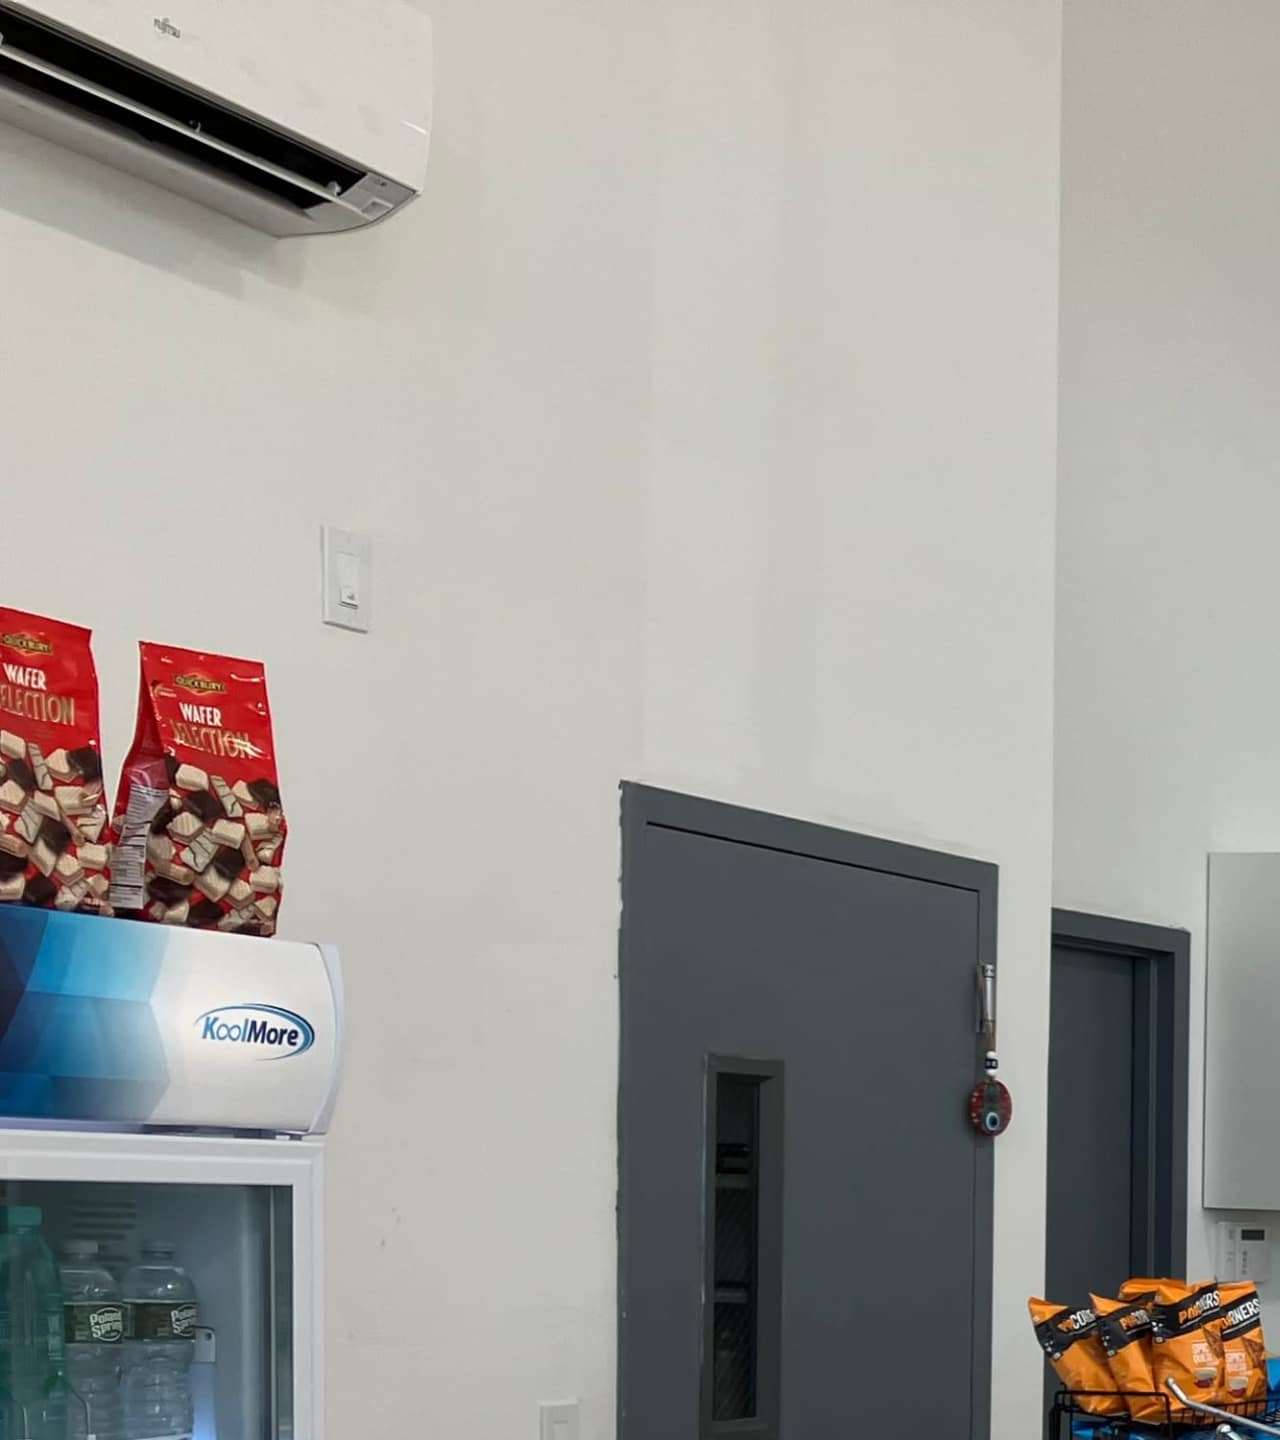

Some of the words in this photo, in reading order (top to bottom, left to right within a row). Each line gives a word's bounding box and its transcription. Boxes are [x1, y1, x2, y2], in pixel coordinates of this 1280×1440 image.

[3, 662, 47, 690] WAFER
[0, 686, 75, 727] ELECTION
[179, 703, 222, 727] WAFER
[202, 1016, 298, 1046] KoolMore
